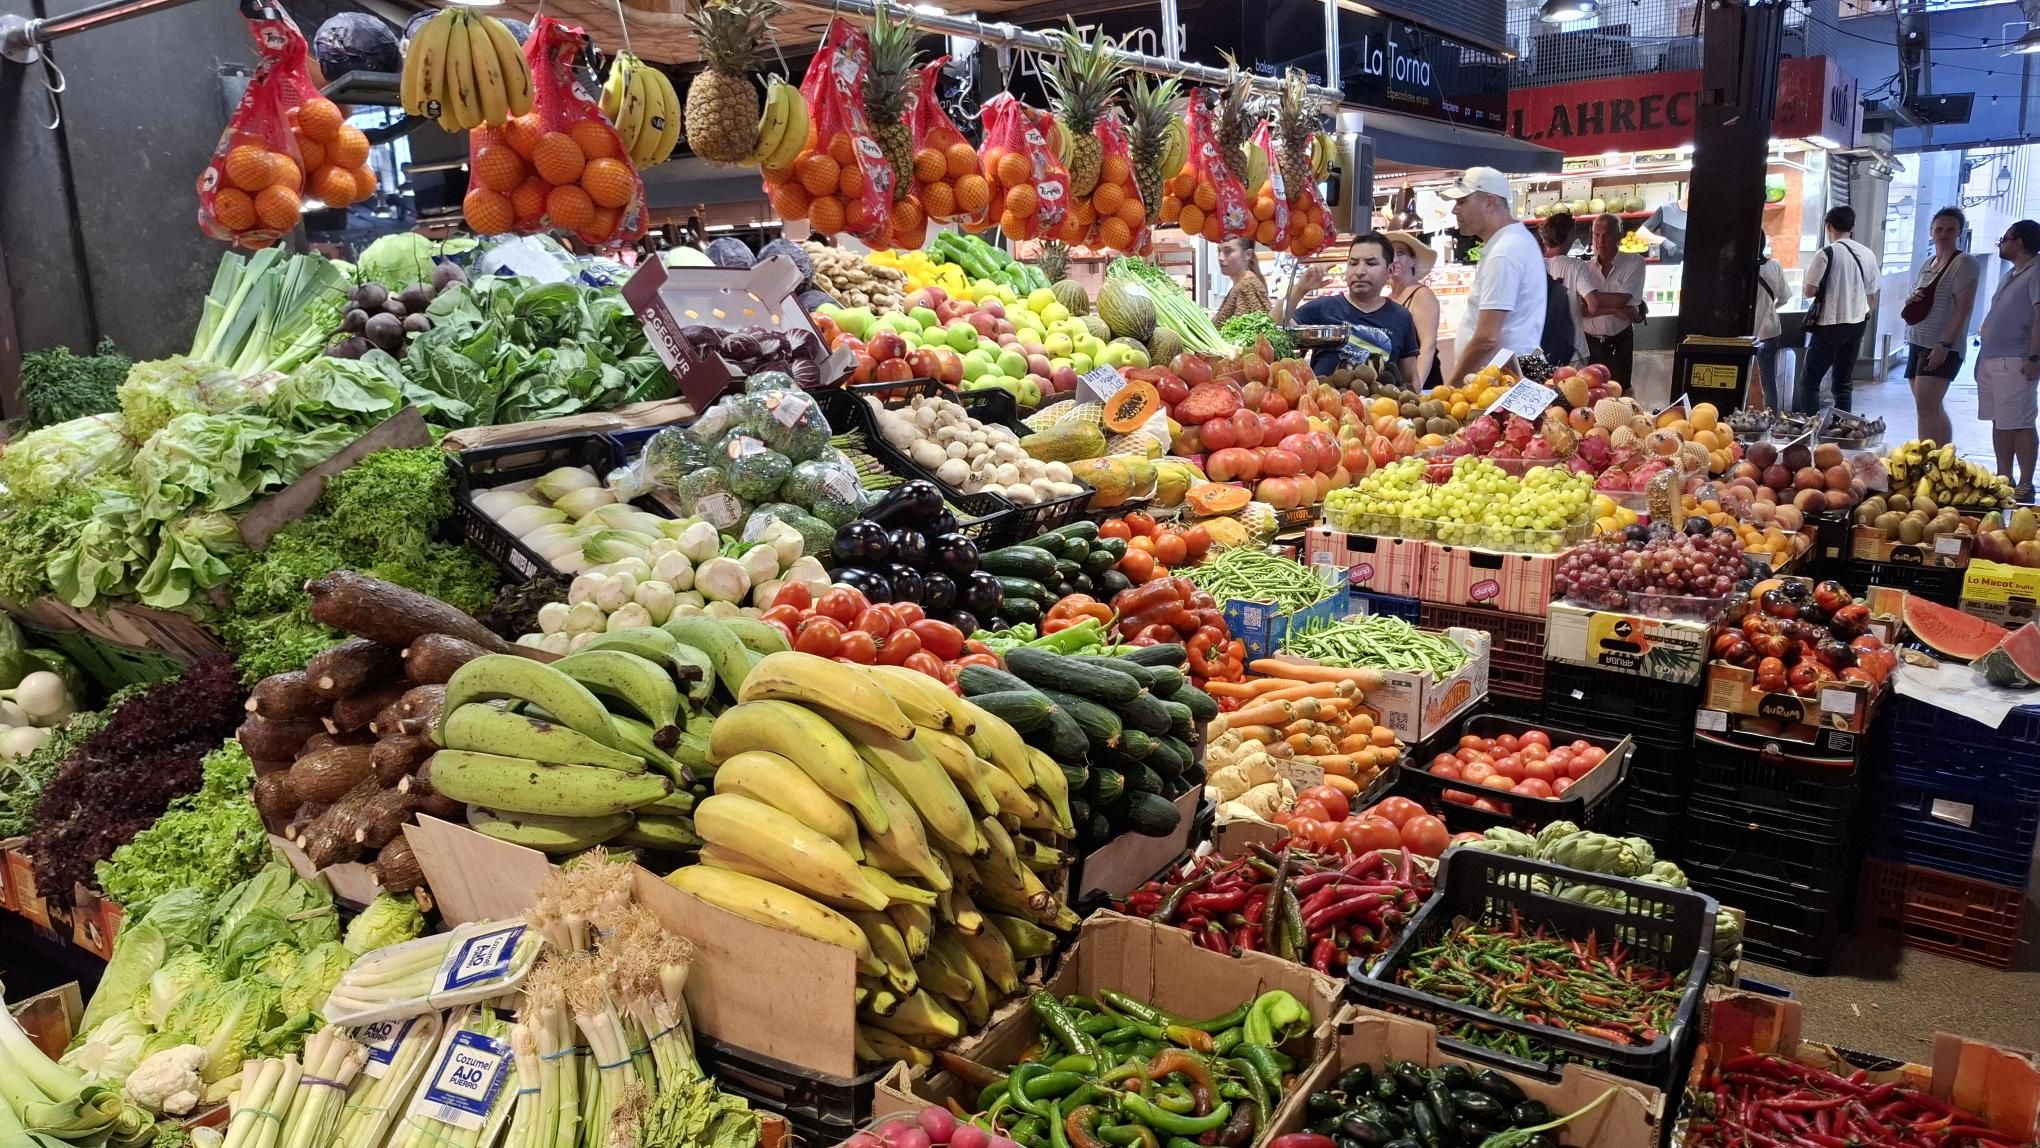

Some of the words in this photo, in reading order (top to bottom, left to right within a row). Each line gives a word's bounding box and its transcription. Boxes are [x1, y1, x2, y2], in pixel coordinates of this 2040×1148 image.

[1255, 56, 1277, 77] bakery
[1363, 34, 1383, 76] La
[1388, 41, 1431, 87] Torna
[653, 316, 690, 376] GEOFUR
[1968, 575, 1980, 584] Lo
[1605, 656, 1634, 668] ARUBA
[1653, 664, 1694, 678] MANGO
[1762, 704, 1801, 720] AuRuM
[473, 944, 491, 967] AJO
[368, 1021, 392, 1036] AJO
[455, 1052, 494, 1072] Cozumel
[452, 1065, 483, 1083] AJO
[449, 1076, 478, 1090] PUERRO
